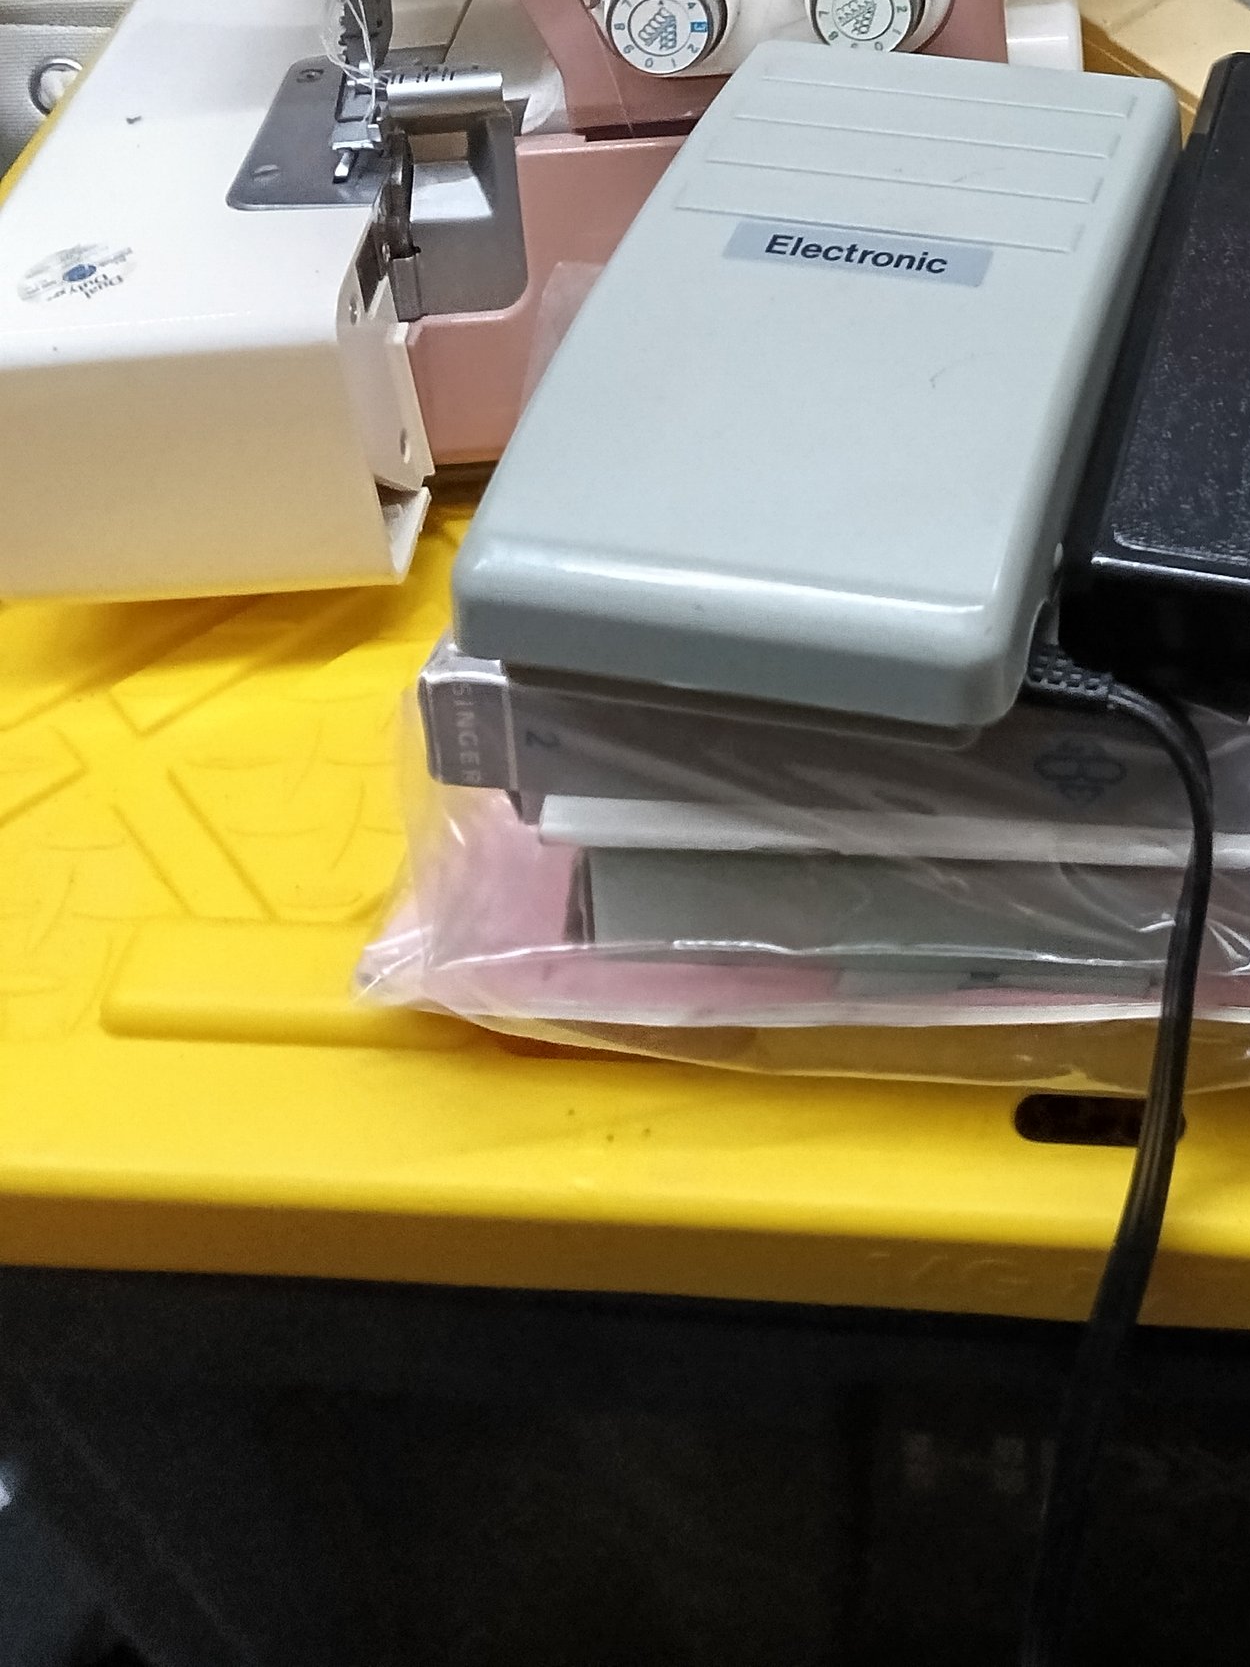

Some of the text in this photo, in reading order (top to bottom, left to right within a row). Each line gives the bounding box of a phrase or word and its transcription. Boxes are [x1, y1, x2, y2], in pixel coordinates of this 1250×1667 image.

[896, 5, 908, 14] 2
[613, 22, 626, 31] 8
[687, 44, 700, 54] 2
[764, 234, 948, 275] Electronic
[83, 274, 124, 299] Dual
